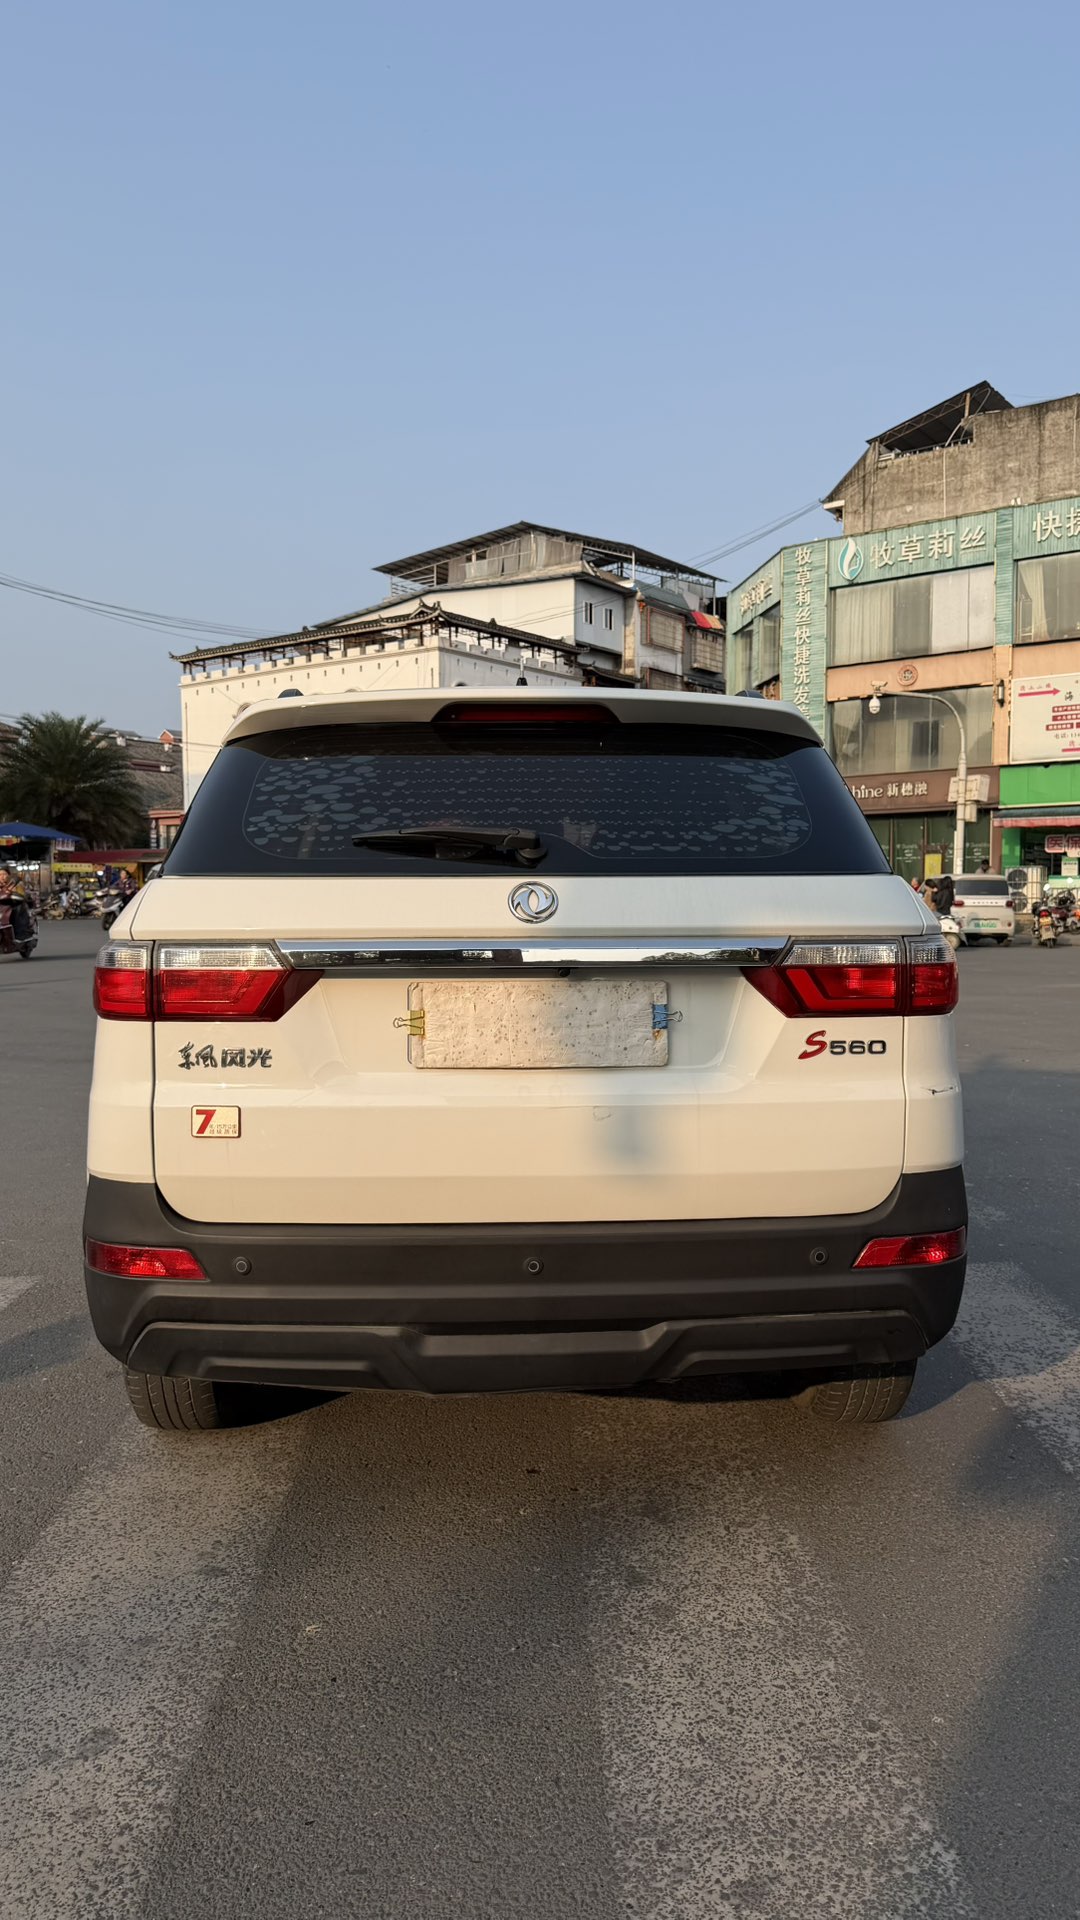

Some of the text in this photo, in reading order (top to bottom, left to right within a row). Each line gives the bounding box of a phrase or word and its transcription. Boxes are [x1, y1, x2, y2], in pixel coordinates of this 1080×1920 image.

[869, 524, 987, 570] 牧草莉丝
[798, 1030, 886, 1060] S560
[195, 1109, 216, 1134] 7
